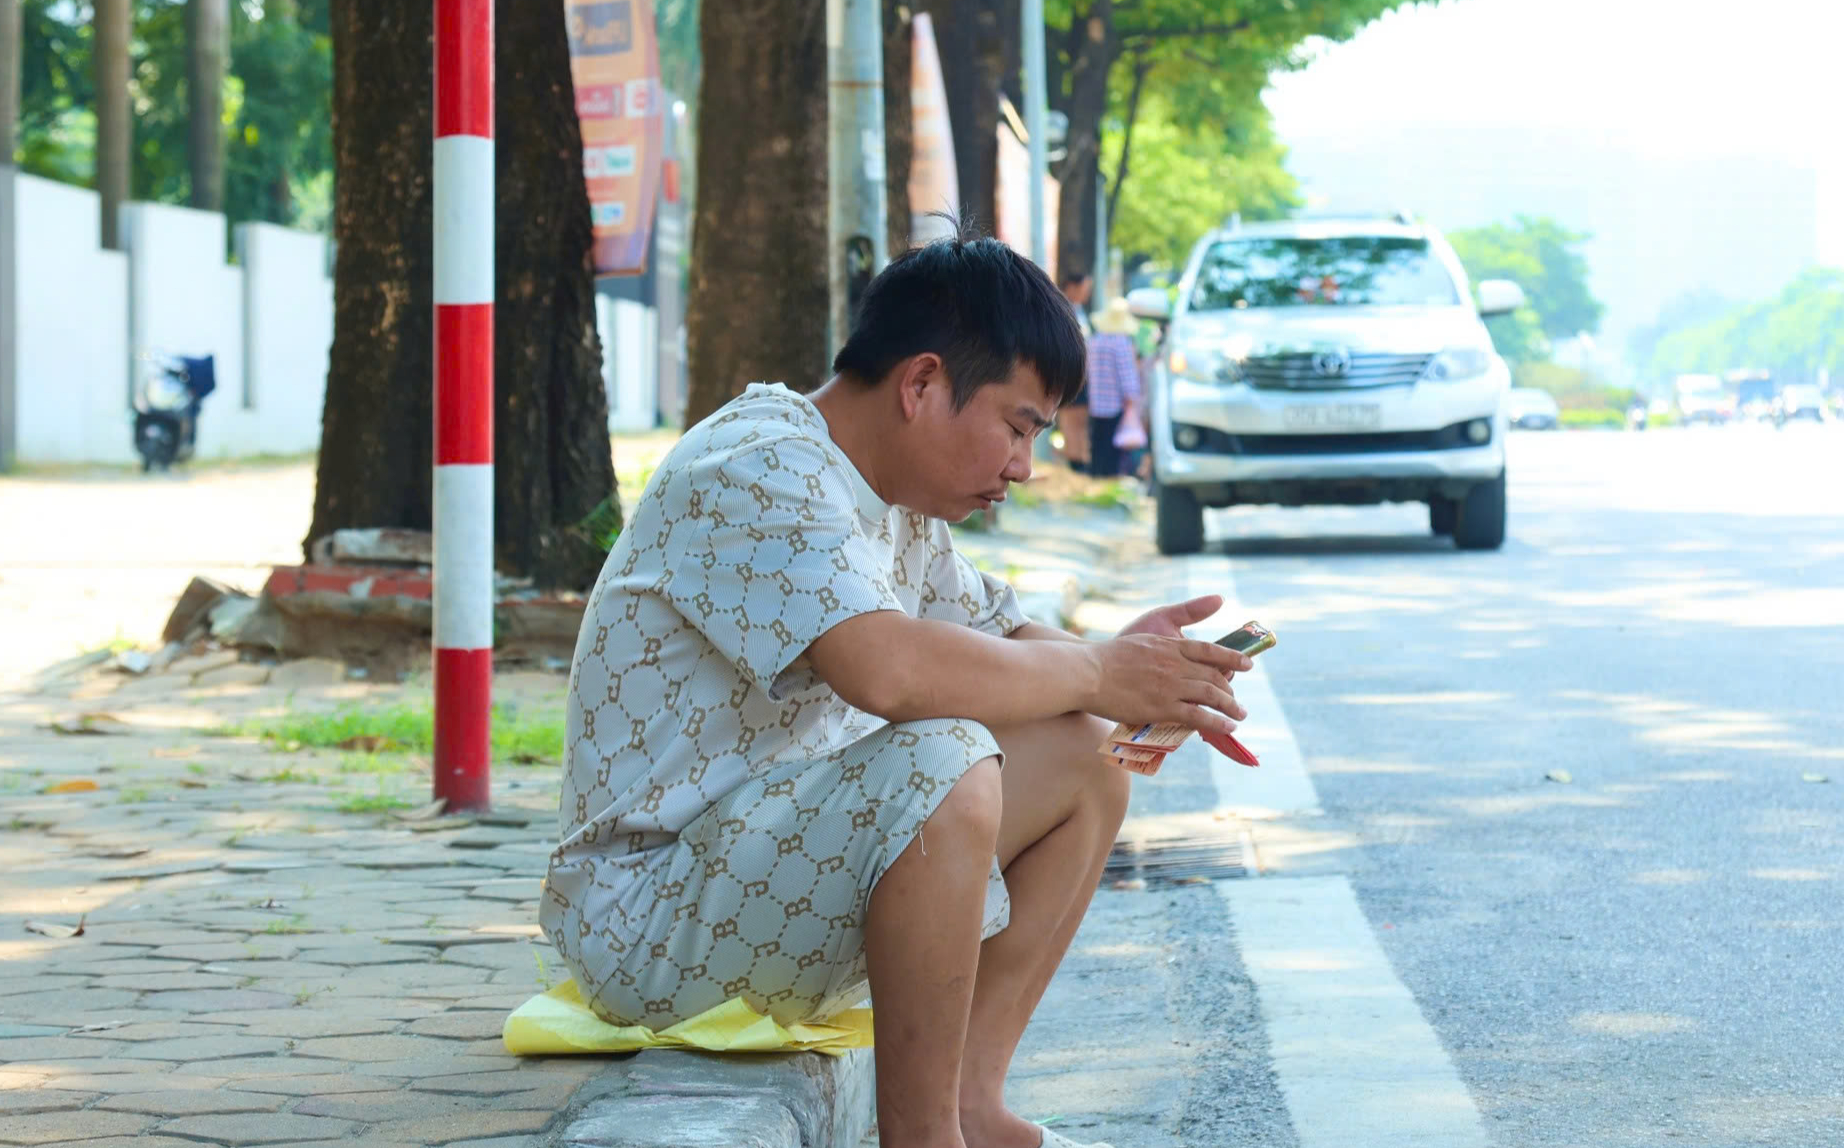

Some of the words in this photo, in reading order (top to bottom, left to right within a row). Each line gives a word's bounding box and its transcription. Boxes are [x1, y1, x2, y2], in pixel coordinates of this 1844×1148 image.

[762, 448, 780, 470] J
[749, 483, 773, 512] B
[787, 529, 808, 554] B
[829, 546, 850, 572] J
[894, 556, 907, 586] J
[772, 569, 794, 597] J
[626, 592, 641, 621] J
[694, 592, 714, 617] B
[815, 586, 840, 612] B
[732, 604, 750, 632] J
[772, 618, 792, 646] B
[594, 626, 608, 656] B
[641, 638, 662, 666] B
[607, 672, 622, 703] J
[664, 679, 682, 710] J
[730, 676, 751, 709] J
[583, 709, 595, 740] B
[681, 706, 706, 738] B
[780, 698, 801, 728] J
[627, 719, 646, 750] B
[733, 726, 756, 755] B
[887, 730, 920, 748] J
[597, 755, 611, 787] J
[688, 753, 710, 785] J
[762, 778, 795, 799] B
[908, 771, 936, 799] B
[576, 793, 587, 824] B
[639, 785, 664, 814] B
[777, 831, 803, 857] B
[816, 855, 844, 875] J
[743, 880, 769, 898] J
[784, 896, 812, 920] B
[712, 918, 738, 942] B
[753, 941, 780, 958] J
[797, 949, 825, 970] B
[680, 964, 708, 981] J
[723, 976, 750, 997] B
[644, 998, 673, 1015] B
